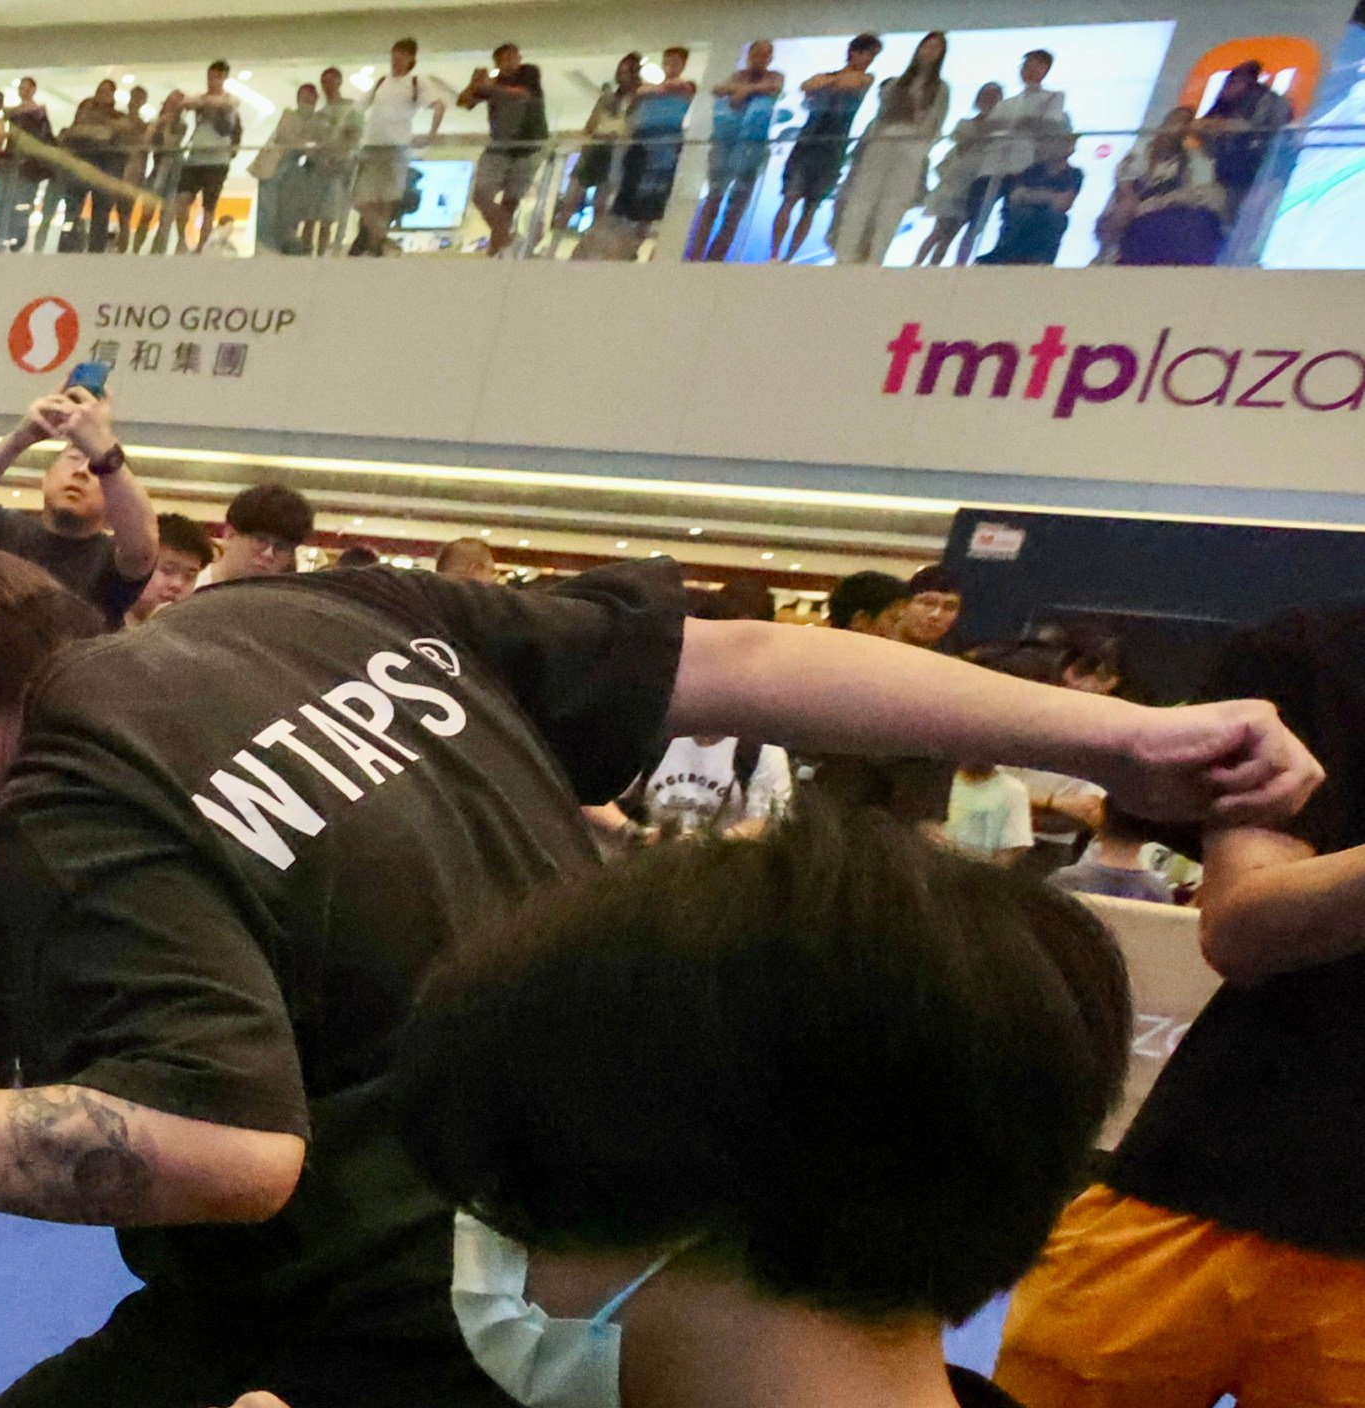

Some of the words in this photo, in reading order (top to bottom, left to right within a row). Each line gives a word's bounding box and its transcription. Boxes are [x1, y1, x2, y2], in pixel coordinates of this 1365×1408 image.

[95, 303, 170, 330] SINO
[179, 306, 295, 335] GROUP
[882, 323, 1365, 419] tmtplaza
